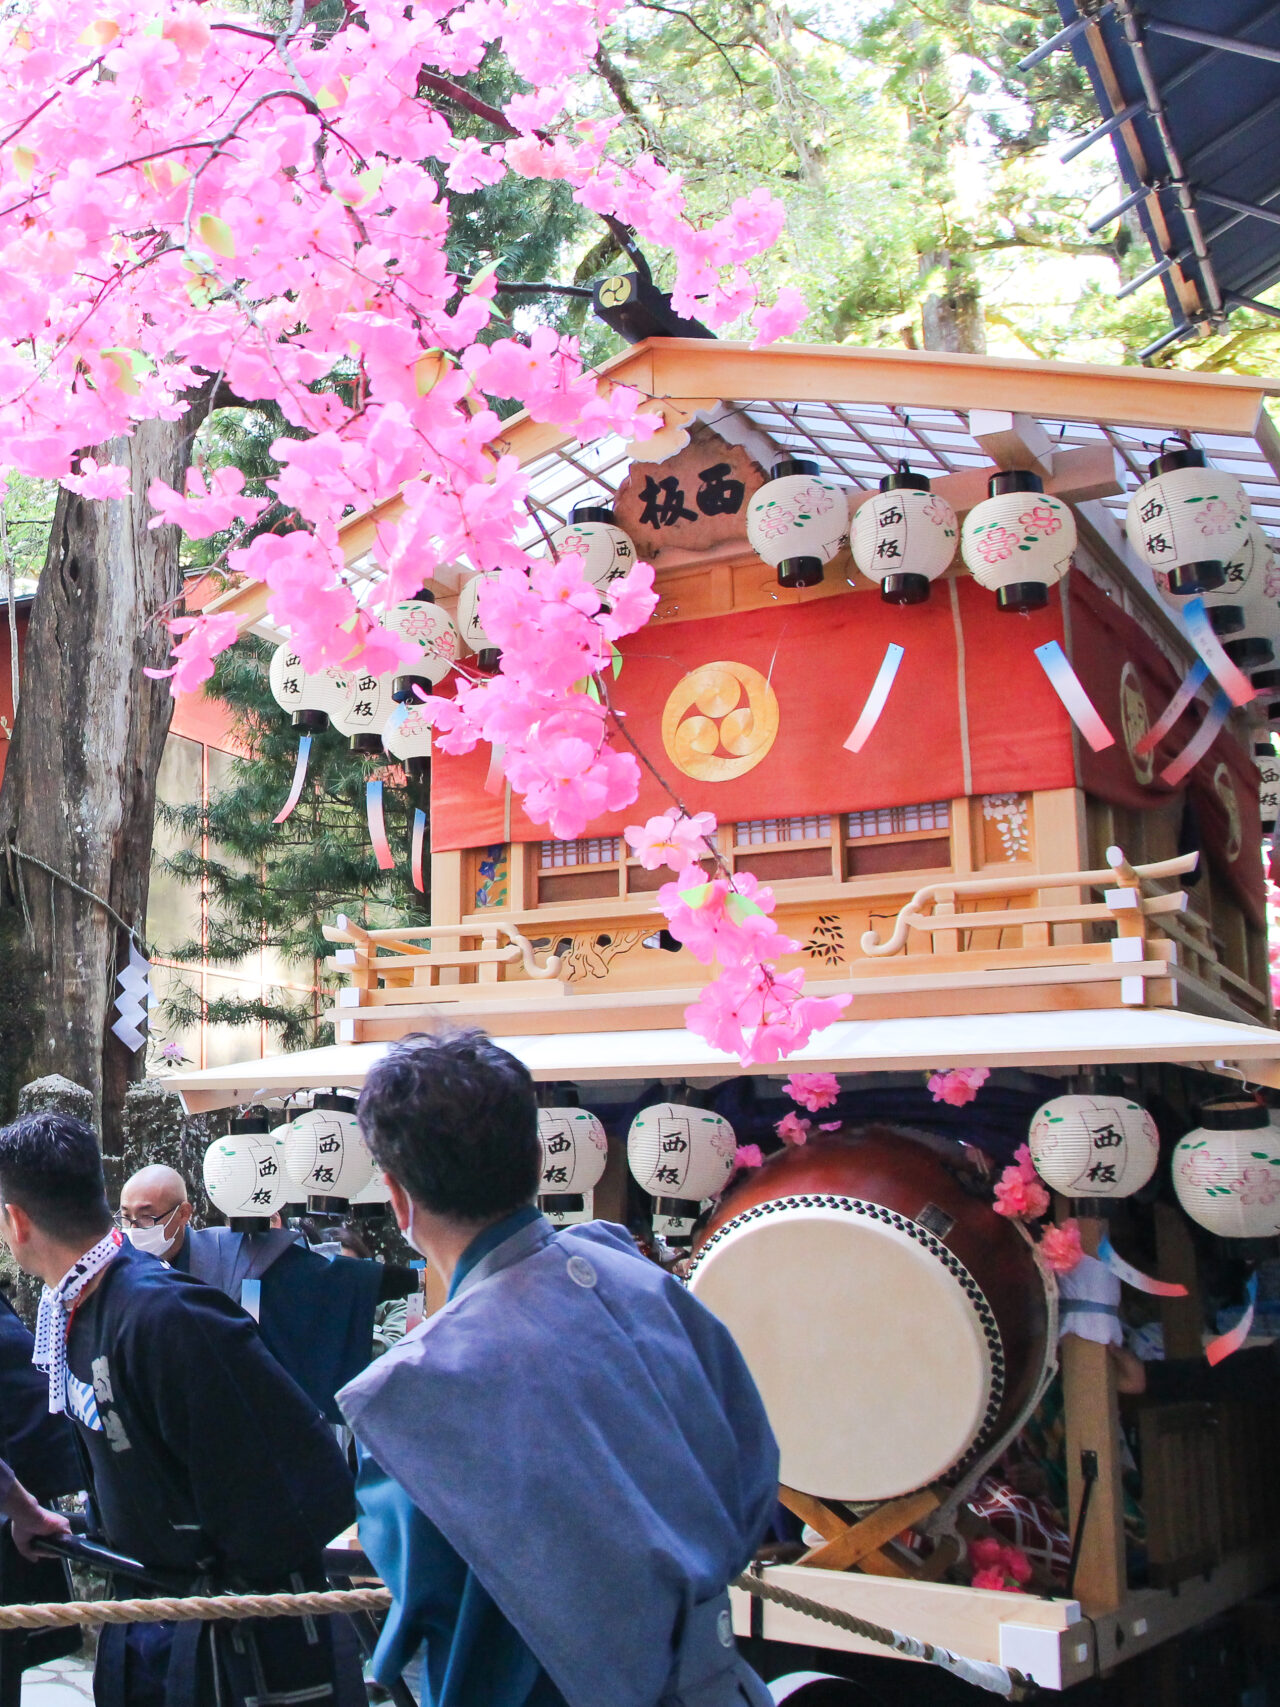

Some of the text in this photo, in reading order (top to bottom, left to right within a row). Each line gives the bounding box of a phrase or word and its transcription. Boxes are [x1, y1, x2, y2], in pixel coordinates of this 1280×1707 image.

[876, 506, 904, 558] 西板
[1140, 498, 1173, 554] 西板
[353, 675, 378, 717] 西板
[313, 1133, 341, 1184] 西板
[543, 1132, 572, 1184] 西板
[656, 1131, 687, 1186] 西板
[1086, 1124, 1122, 1184] 西板
[251, 1156, 278, 1206] 西板
